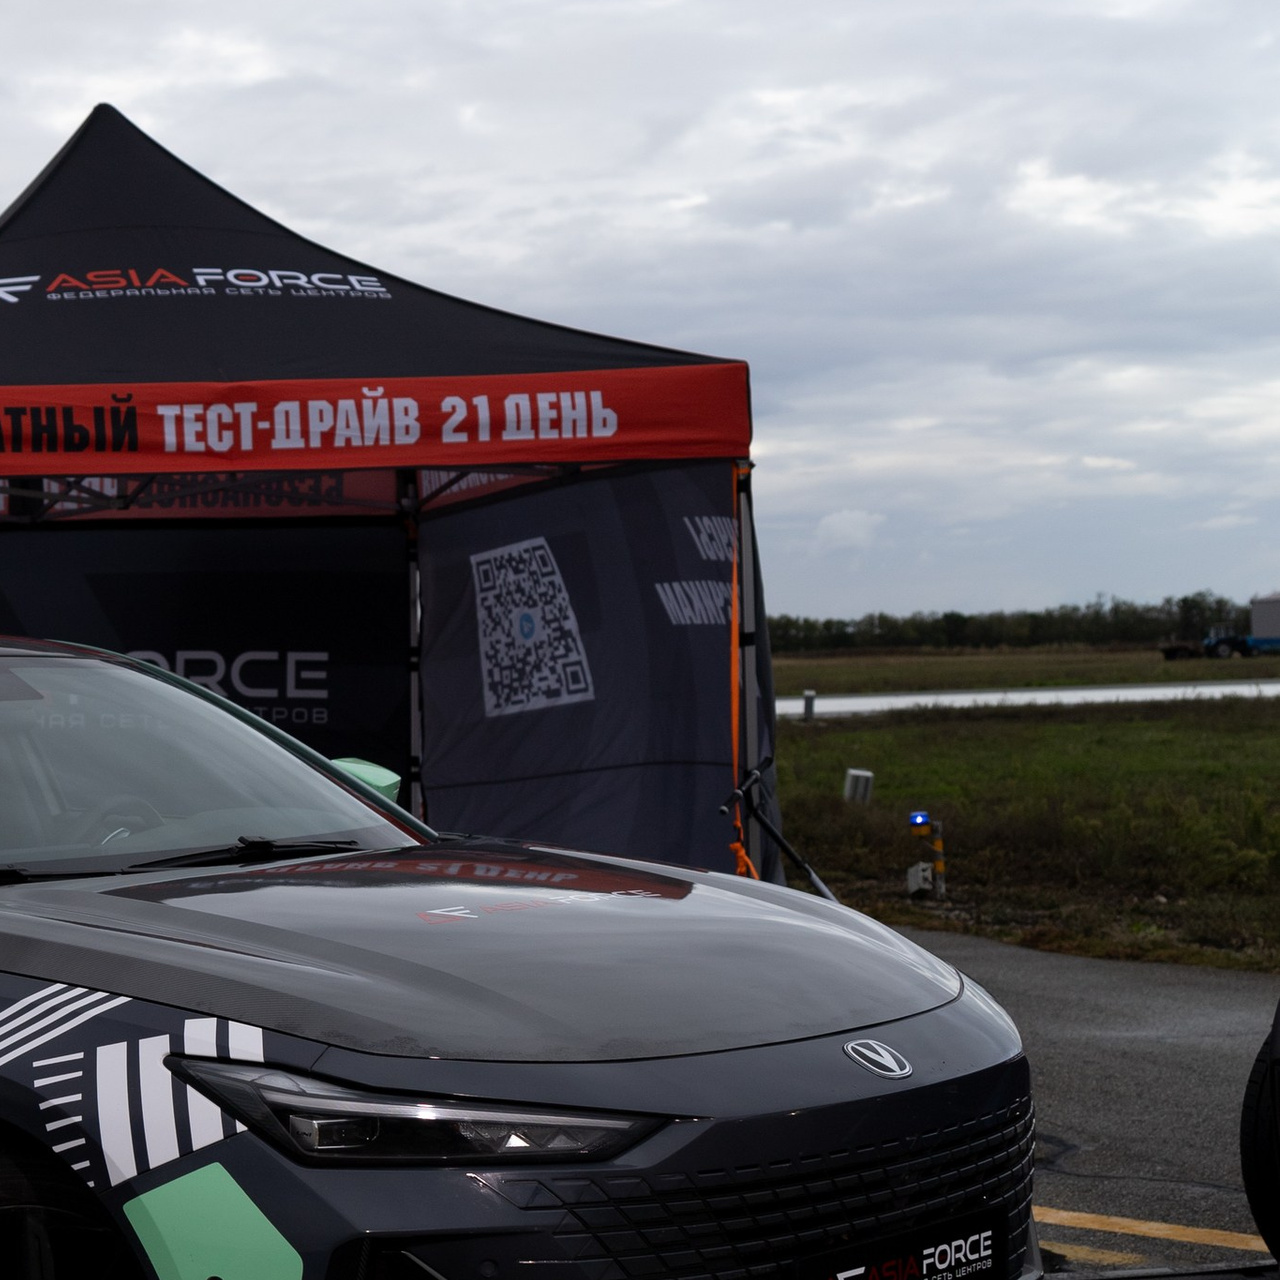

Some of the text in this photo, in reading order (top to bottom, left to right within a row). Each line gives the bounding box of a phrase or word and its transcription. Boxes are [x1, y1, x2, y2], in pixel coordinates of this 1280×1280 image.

[46, 267, 189, 292] ASIA
[192, 268, 388, 293] FORCE
[46, 286, 393, 301] ФЕДЕРАЛЬНАЯ СЕТЬ ЦЕНТРОВ
[157, 386, 421, 453] ТЕСТ-ДРАЙВ
[440, 395, 491, 443] 21
[501, 390, 619, 441] ДЕНЬ
[922, 1230, 992, 1275] FORCE
[955, 1259, 993, 1278] ЦЕНТРОВ
